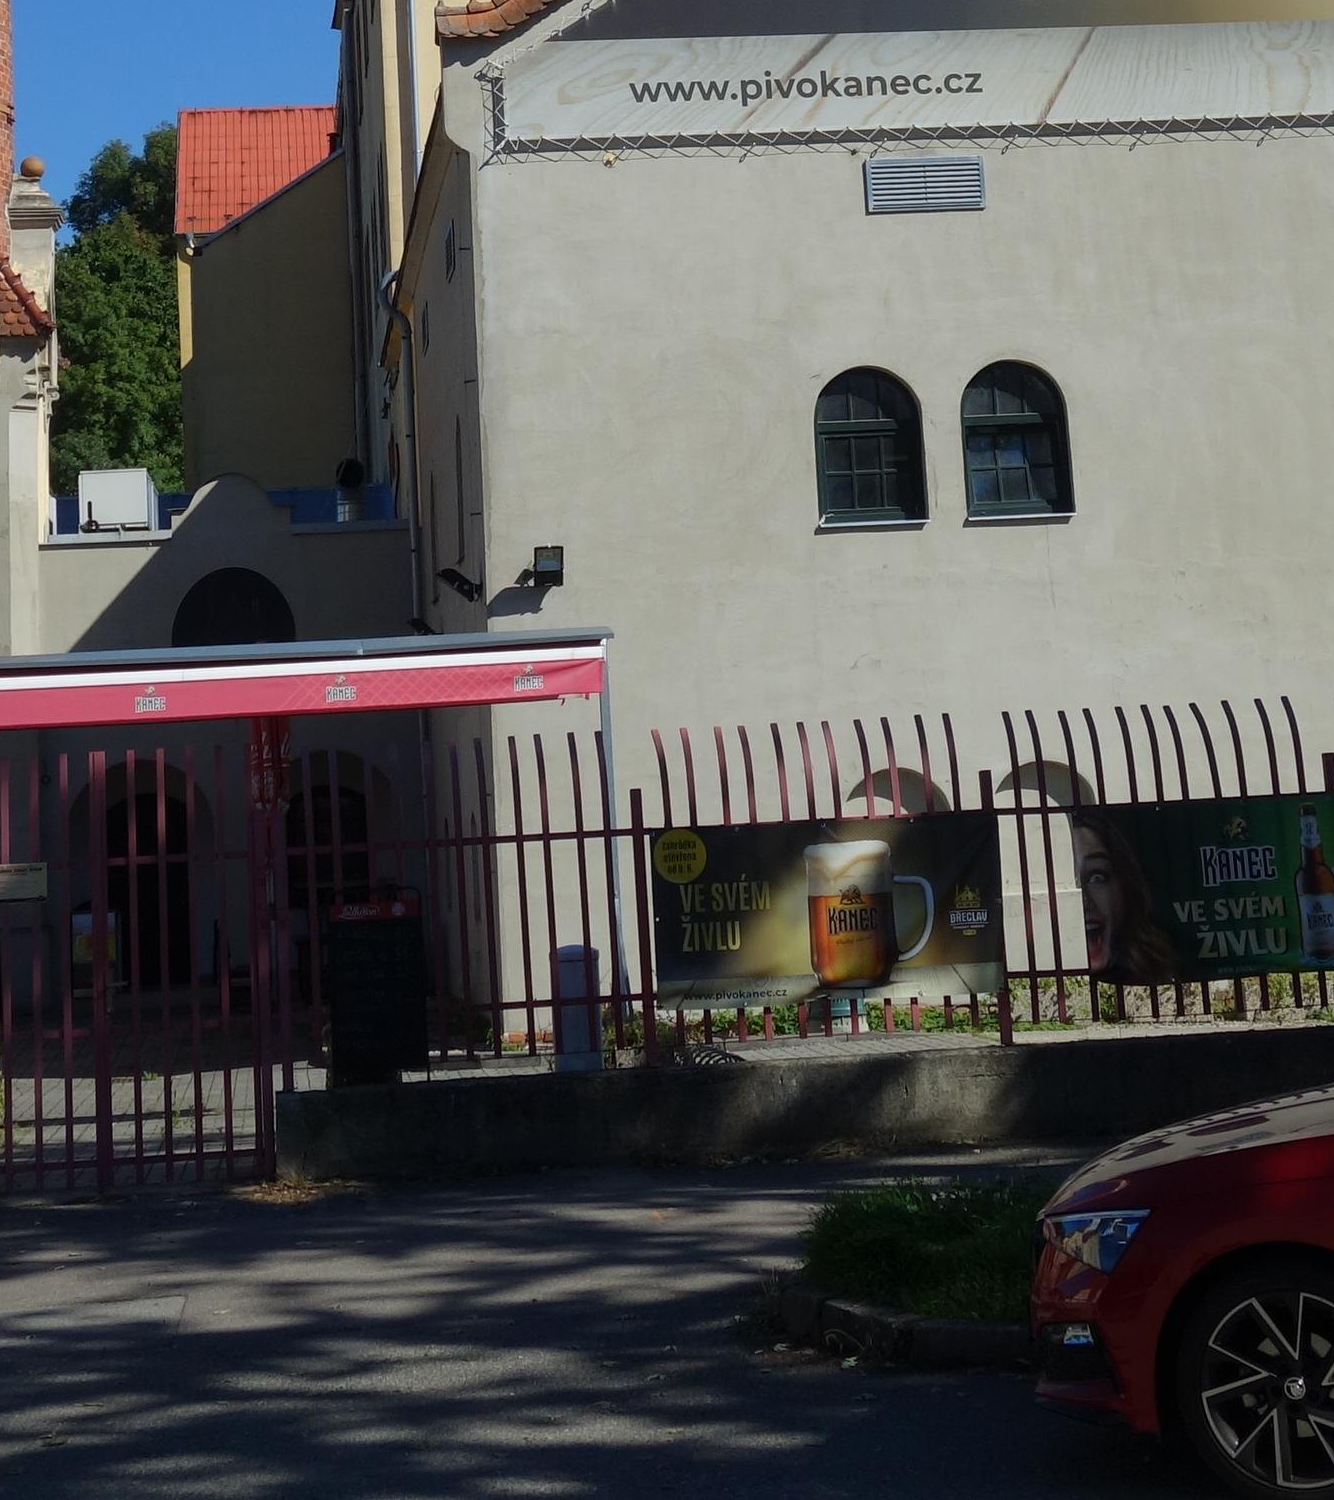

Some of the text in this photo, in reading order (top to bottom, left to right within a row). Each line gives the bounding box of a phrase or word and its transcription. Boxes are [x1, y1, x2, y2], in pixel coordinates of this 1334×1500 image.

[629, 71, 983, 106] www.pivokanec.cz
[325, 685, 357, 703] KANEC
[513, 675, 545, 693] KANEC
[134, 696, 166, 713] KANEC
[1200, 846, 1278, 887] KANEC
[680, 874, 771, 913] VE SVÉM
[1173, 892, 1286, 923] VE SVÉM
[682, 916, 742, 952] ŽIVLU
[827, 907, 878, 935] KANEC
[1197, 927, 1289, 958] ŽIVLU
[683, 988, 788, 1002] www.pivokanec.cz
